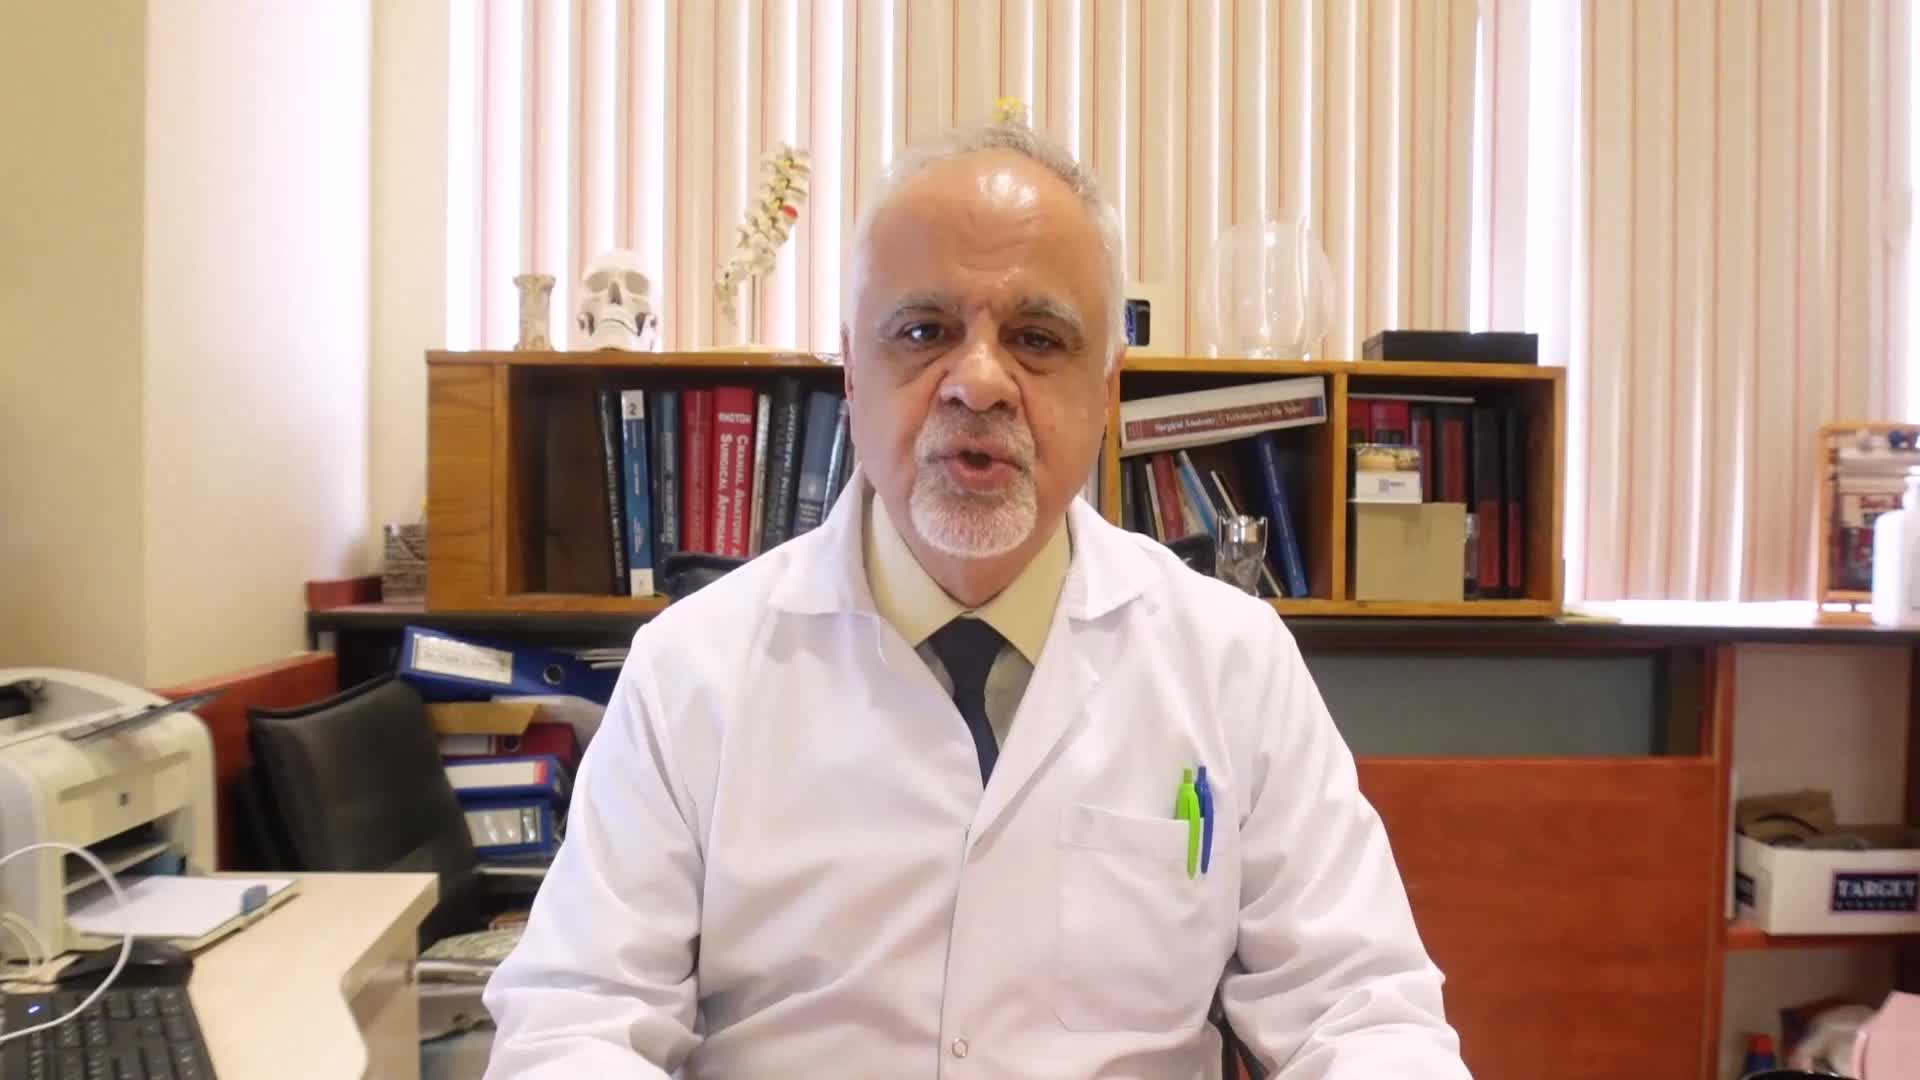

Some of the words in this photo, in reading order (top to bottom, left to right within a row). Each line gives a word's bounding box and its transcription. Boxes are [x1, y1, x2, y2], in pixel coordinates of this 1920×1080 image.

[629, 403, 638, 416] 2
[1154, 419, 1184, 432] Surgical
[718, 432, 733, 491] SURGICAL
[734, 434, 750, 485] CRANIAL
[731, 488, 746, 544] ANATOMY
[1838, 879, 1914, 898] TARGET
